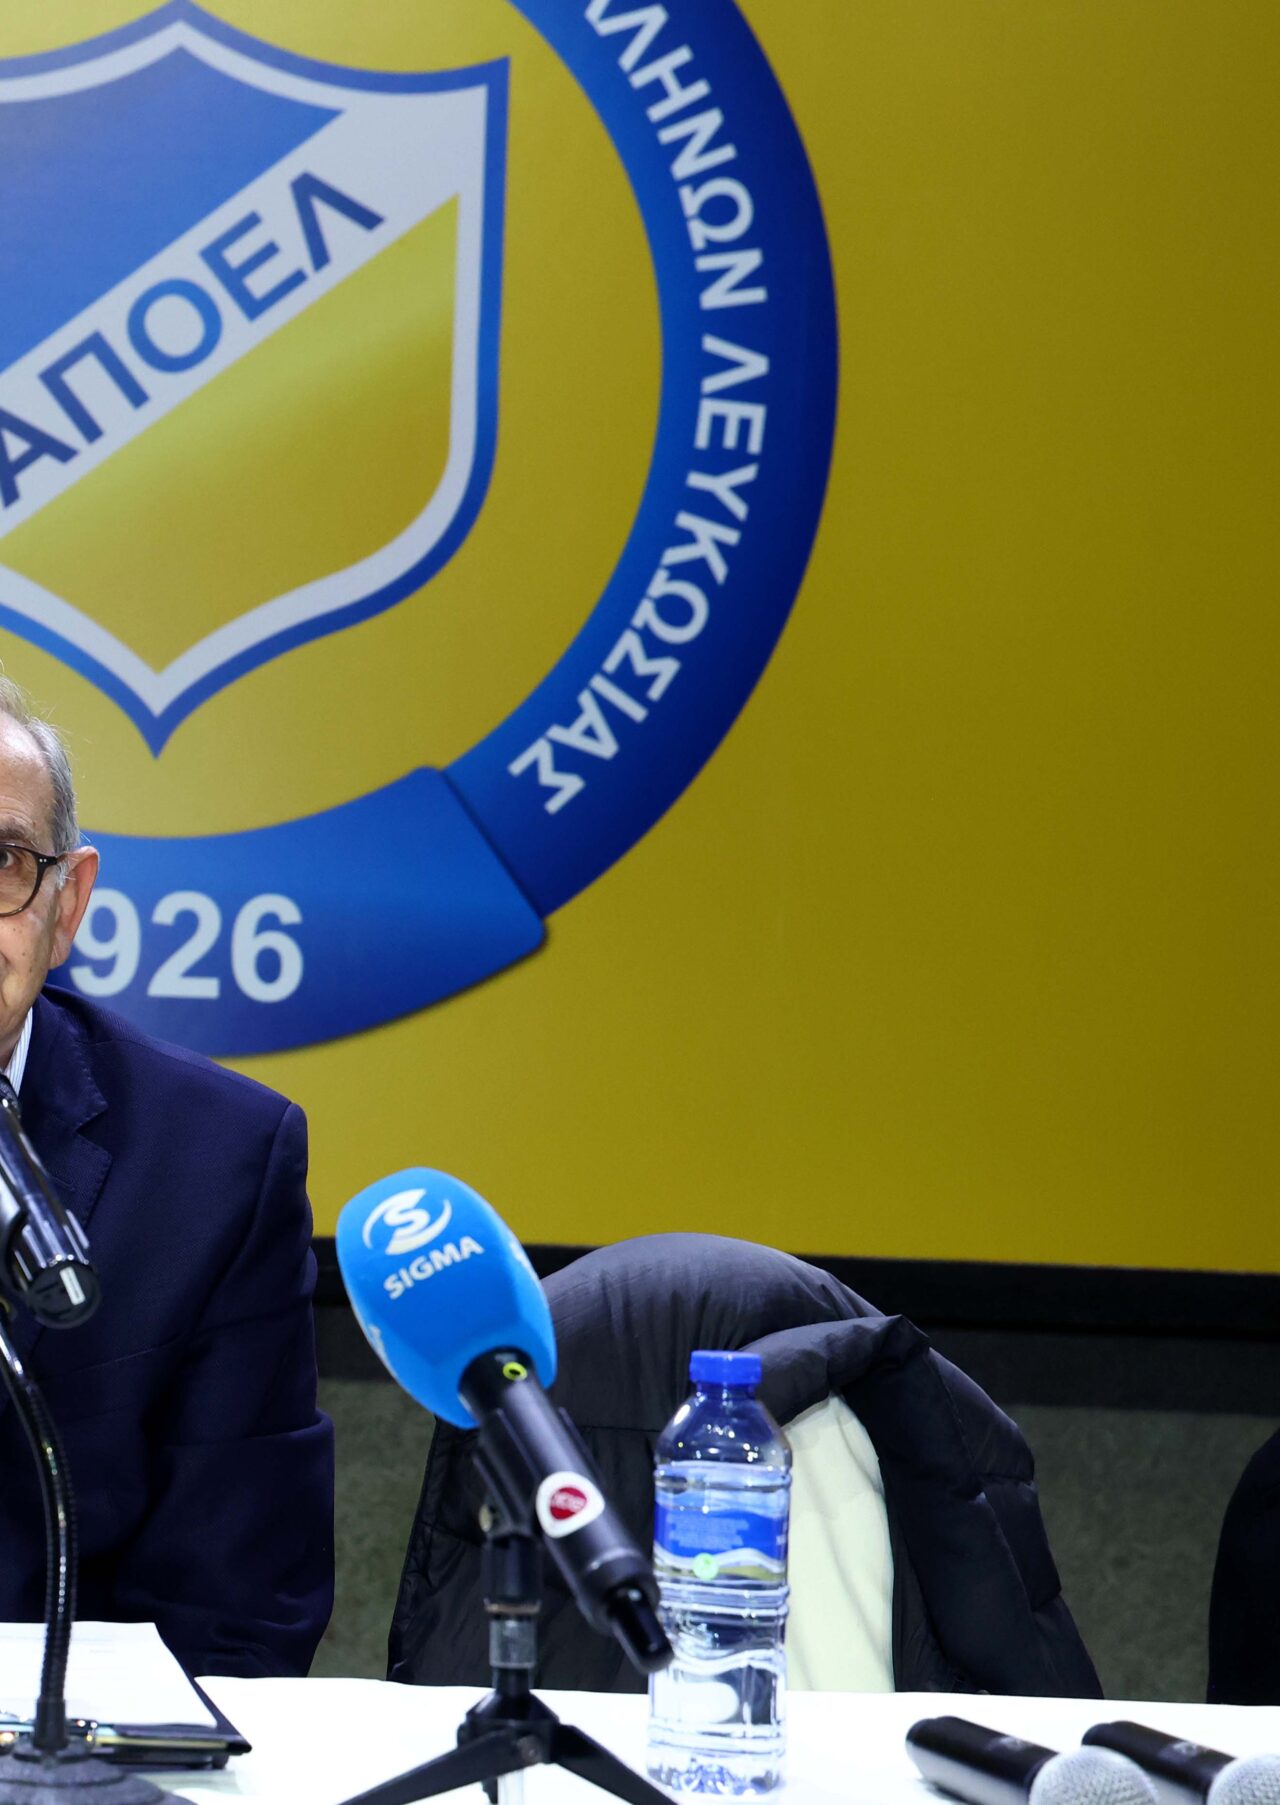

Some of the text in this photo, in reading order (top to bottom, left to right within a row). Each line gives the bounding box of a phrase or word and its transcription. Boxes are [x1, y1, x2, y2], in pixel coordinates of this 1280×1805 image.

[508, 333, 769, 815] ΛΕΥΚΩΣΙΑΣ
[70, 887, 303, 1003] 926
[383, 1236, 485, 1300] SIGMA
